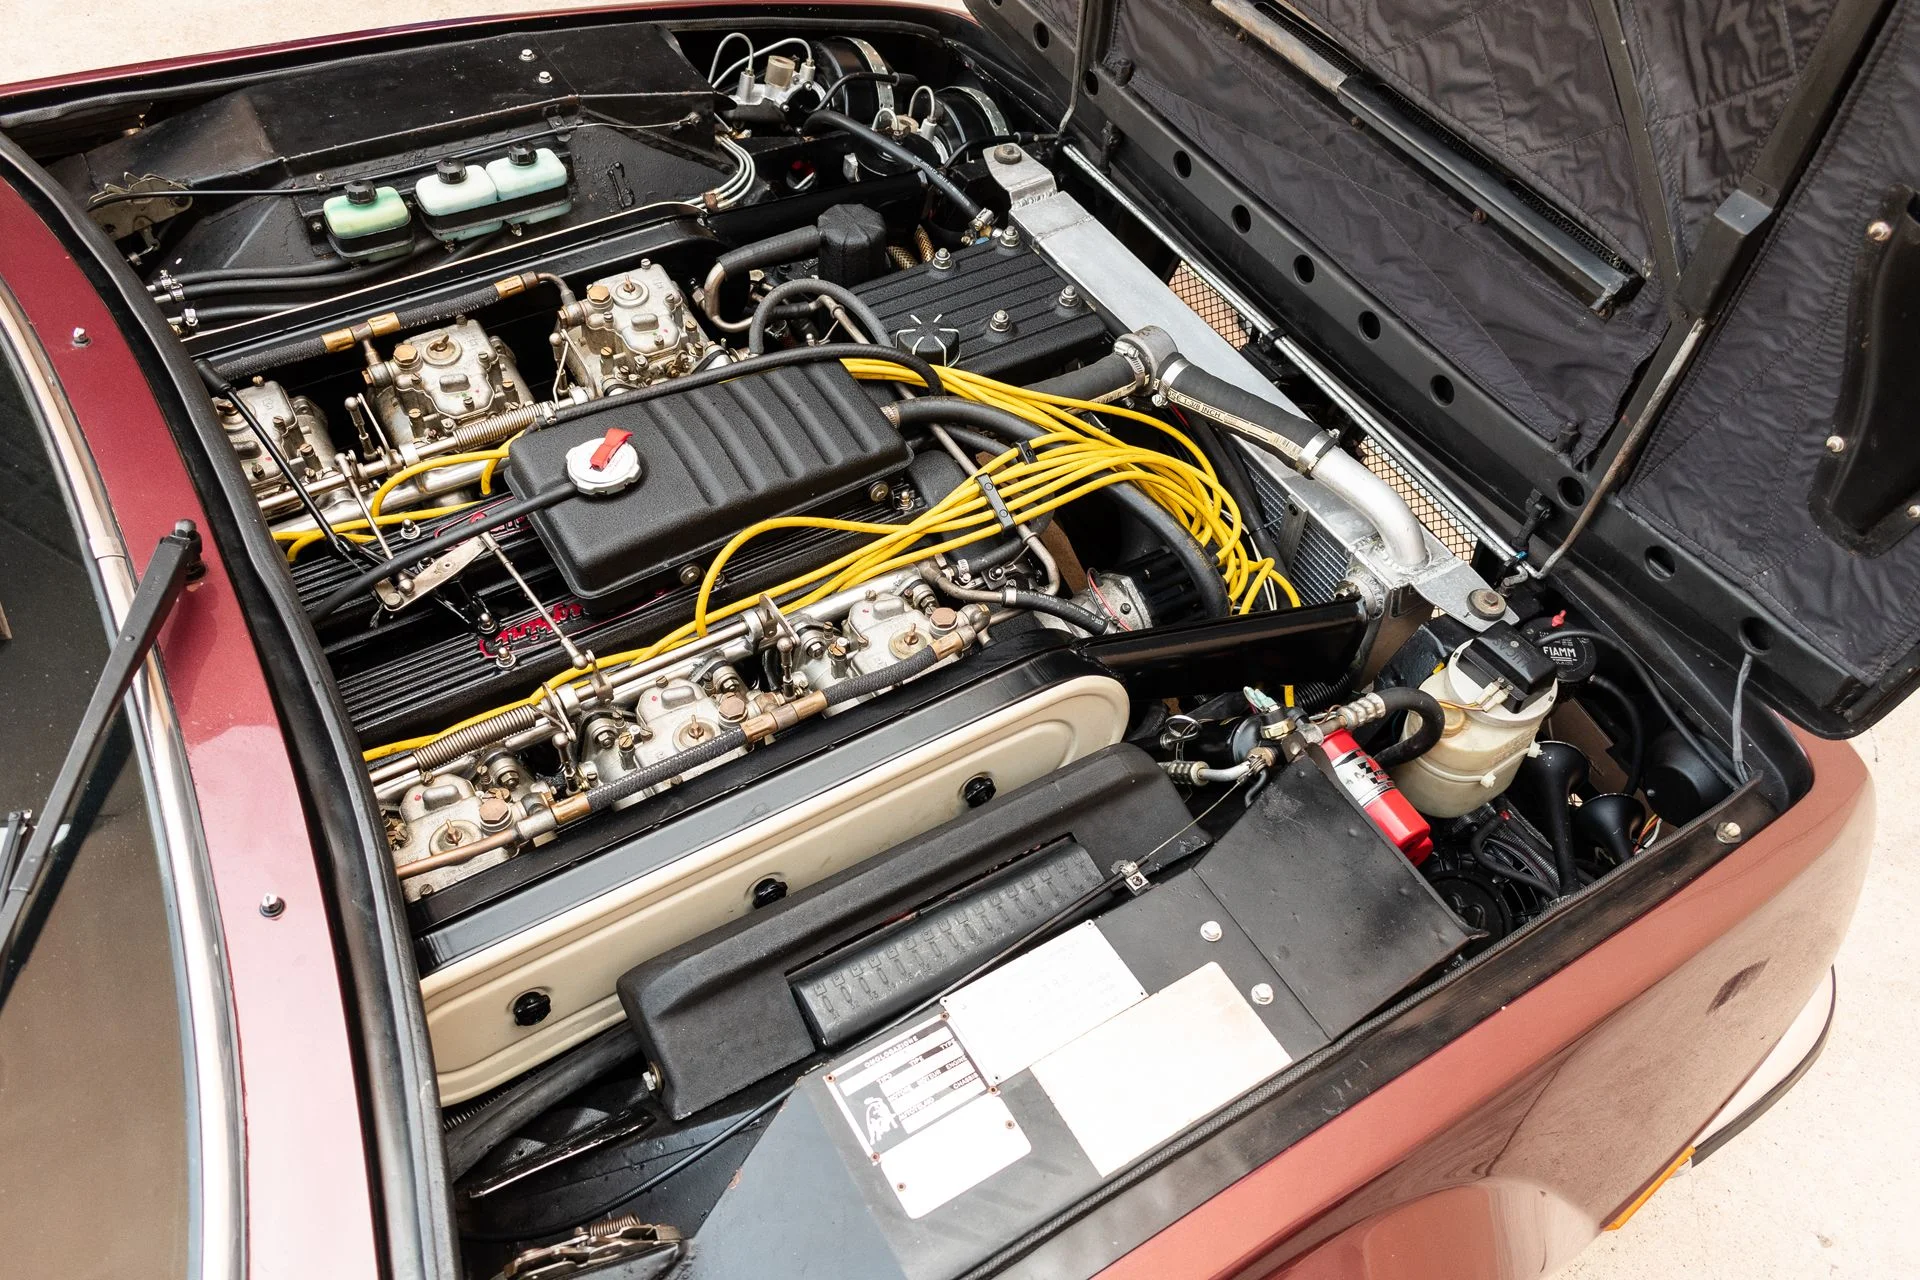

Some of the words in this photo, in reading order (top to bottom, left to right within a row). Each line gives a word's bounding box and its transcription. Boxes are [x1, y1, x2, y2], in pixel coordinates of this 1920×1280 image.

[1201, 406, 1221, 418] INCH
[1543, 646, 1577, 658] FIAMM
[864, 1035, 919, 1068] OMOLOGAZIONE
[953, 1073, 979, 1090] CHASSIS
